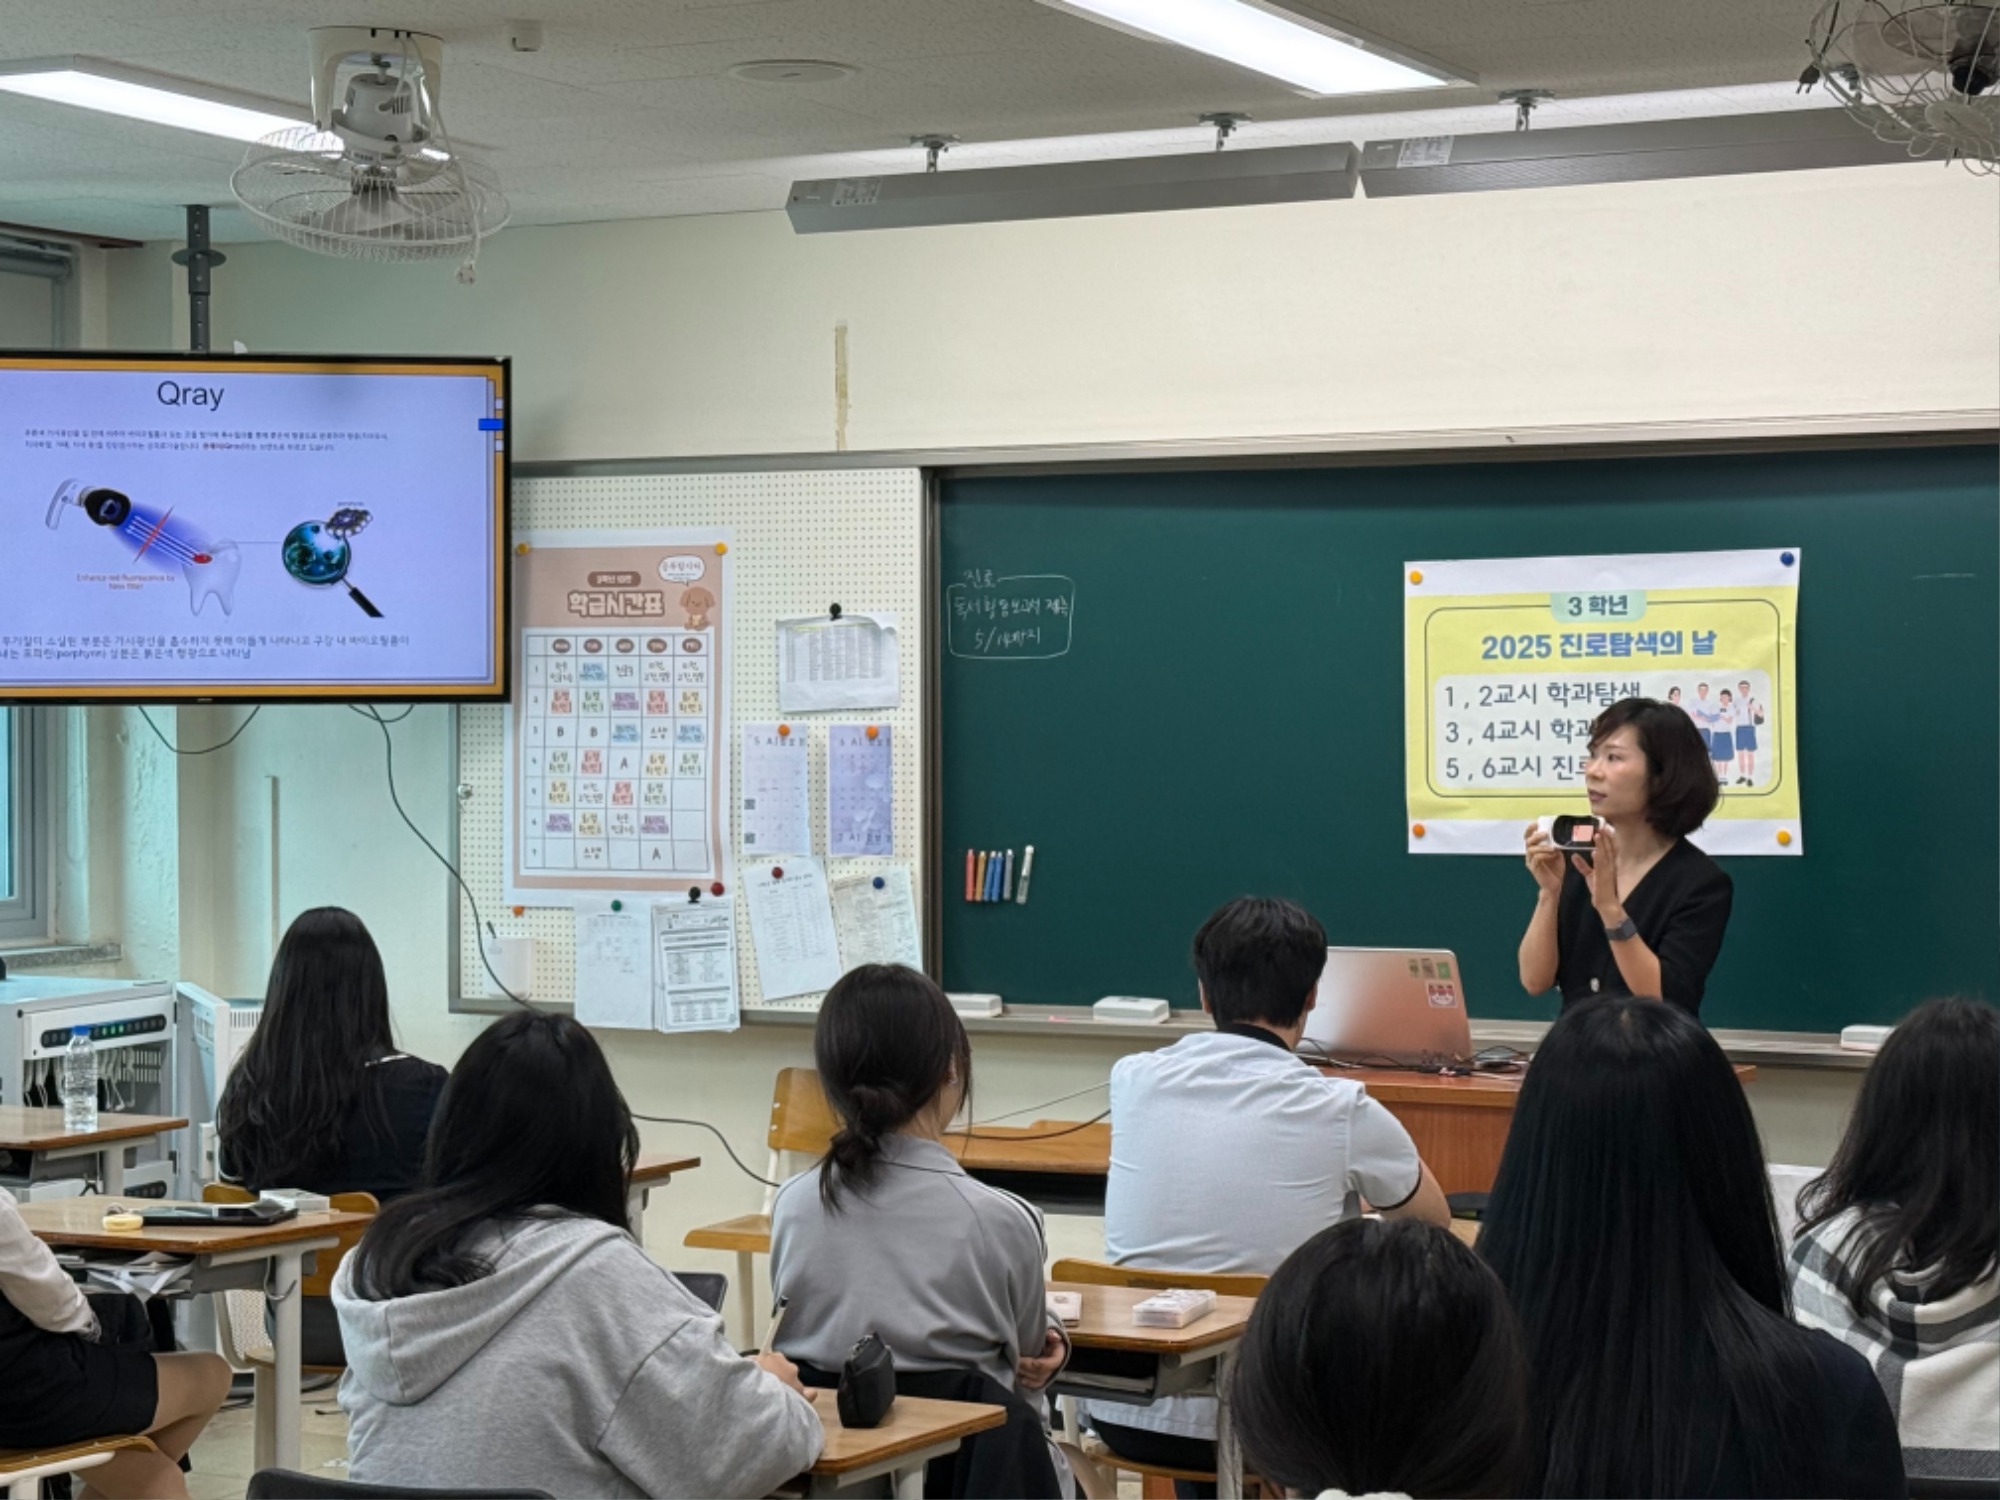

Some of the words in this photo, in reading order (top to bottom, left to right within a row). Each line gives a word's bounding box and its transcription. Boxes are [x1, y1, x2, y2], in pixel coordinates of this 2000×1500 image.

[157, 380, 225, 411] Qray
[568, 590, 665, 617] 학급시간표
[1568, 596, 1583, 617] 3
[1588, 594, 1629, 617] 학년
[1482, 634, 1552, 661] 2025
[1560, 629, 1684, 659] 진로탐색의
[1692, 629, 1718, 657] 날
[1445, 686, 1453, 707] 1
[1479, 682, 1537, 707] 2교시
[557, 726, 565, 737] B
[590, 726, 598, 737] B
[1446, 721, 1459, 743] 3
[1482, 719, 1541, 743] 4교시
[620, 757, 628, 769] A
[1446, 757, 1459, 779] 5
[1482, 755, 1541, 779] 6교시
[652, 848, 661, 860] A
